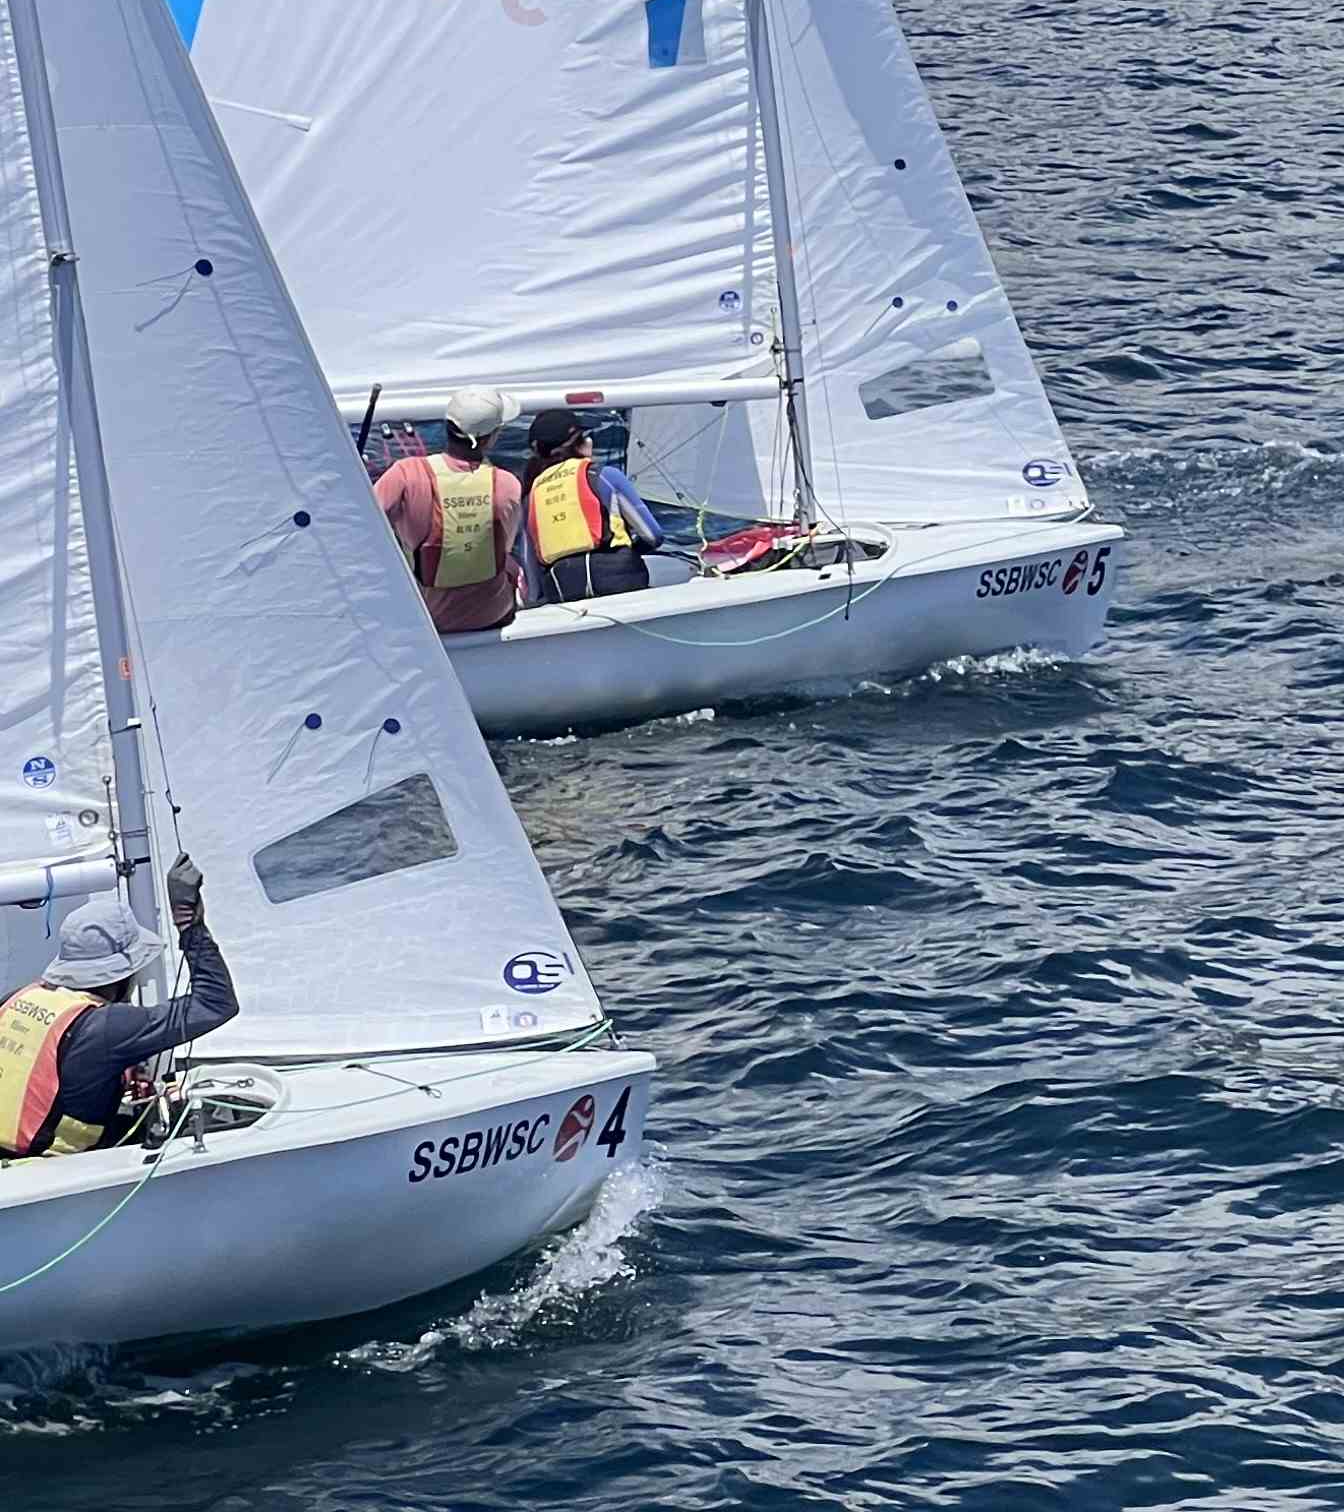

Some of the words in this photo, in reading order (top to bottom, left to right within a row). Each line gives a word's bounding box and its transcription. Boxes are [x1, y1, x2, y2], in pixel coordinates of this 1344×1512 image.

[976, 558, 1062, 598] SSBWSC
[1087, 546, 1111, 596] 5
[408, 1113, 550, 1183] SSBWSC
[596, 1085, 632, 1158] 4
